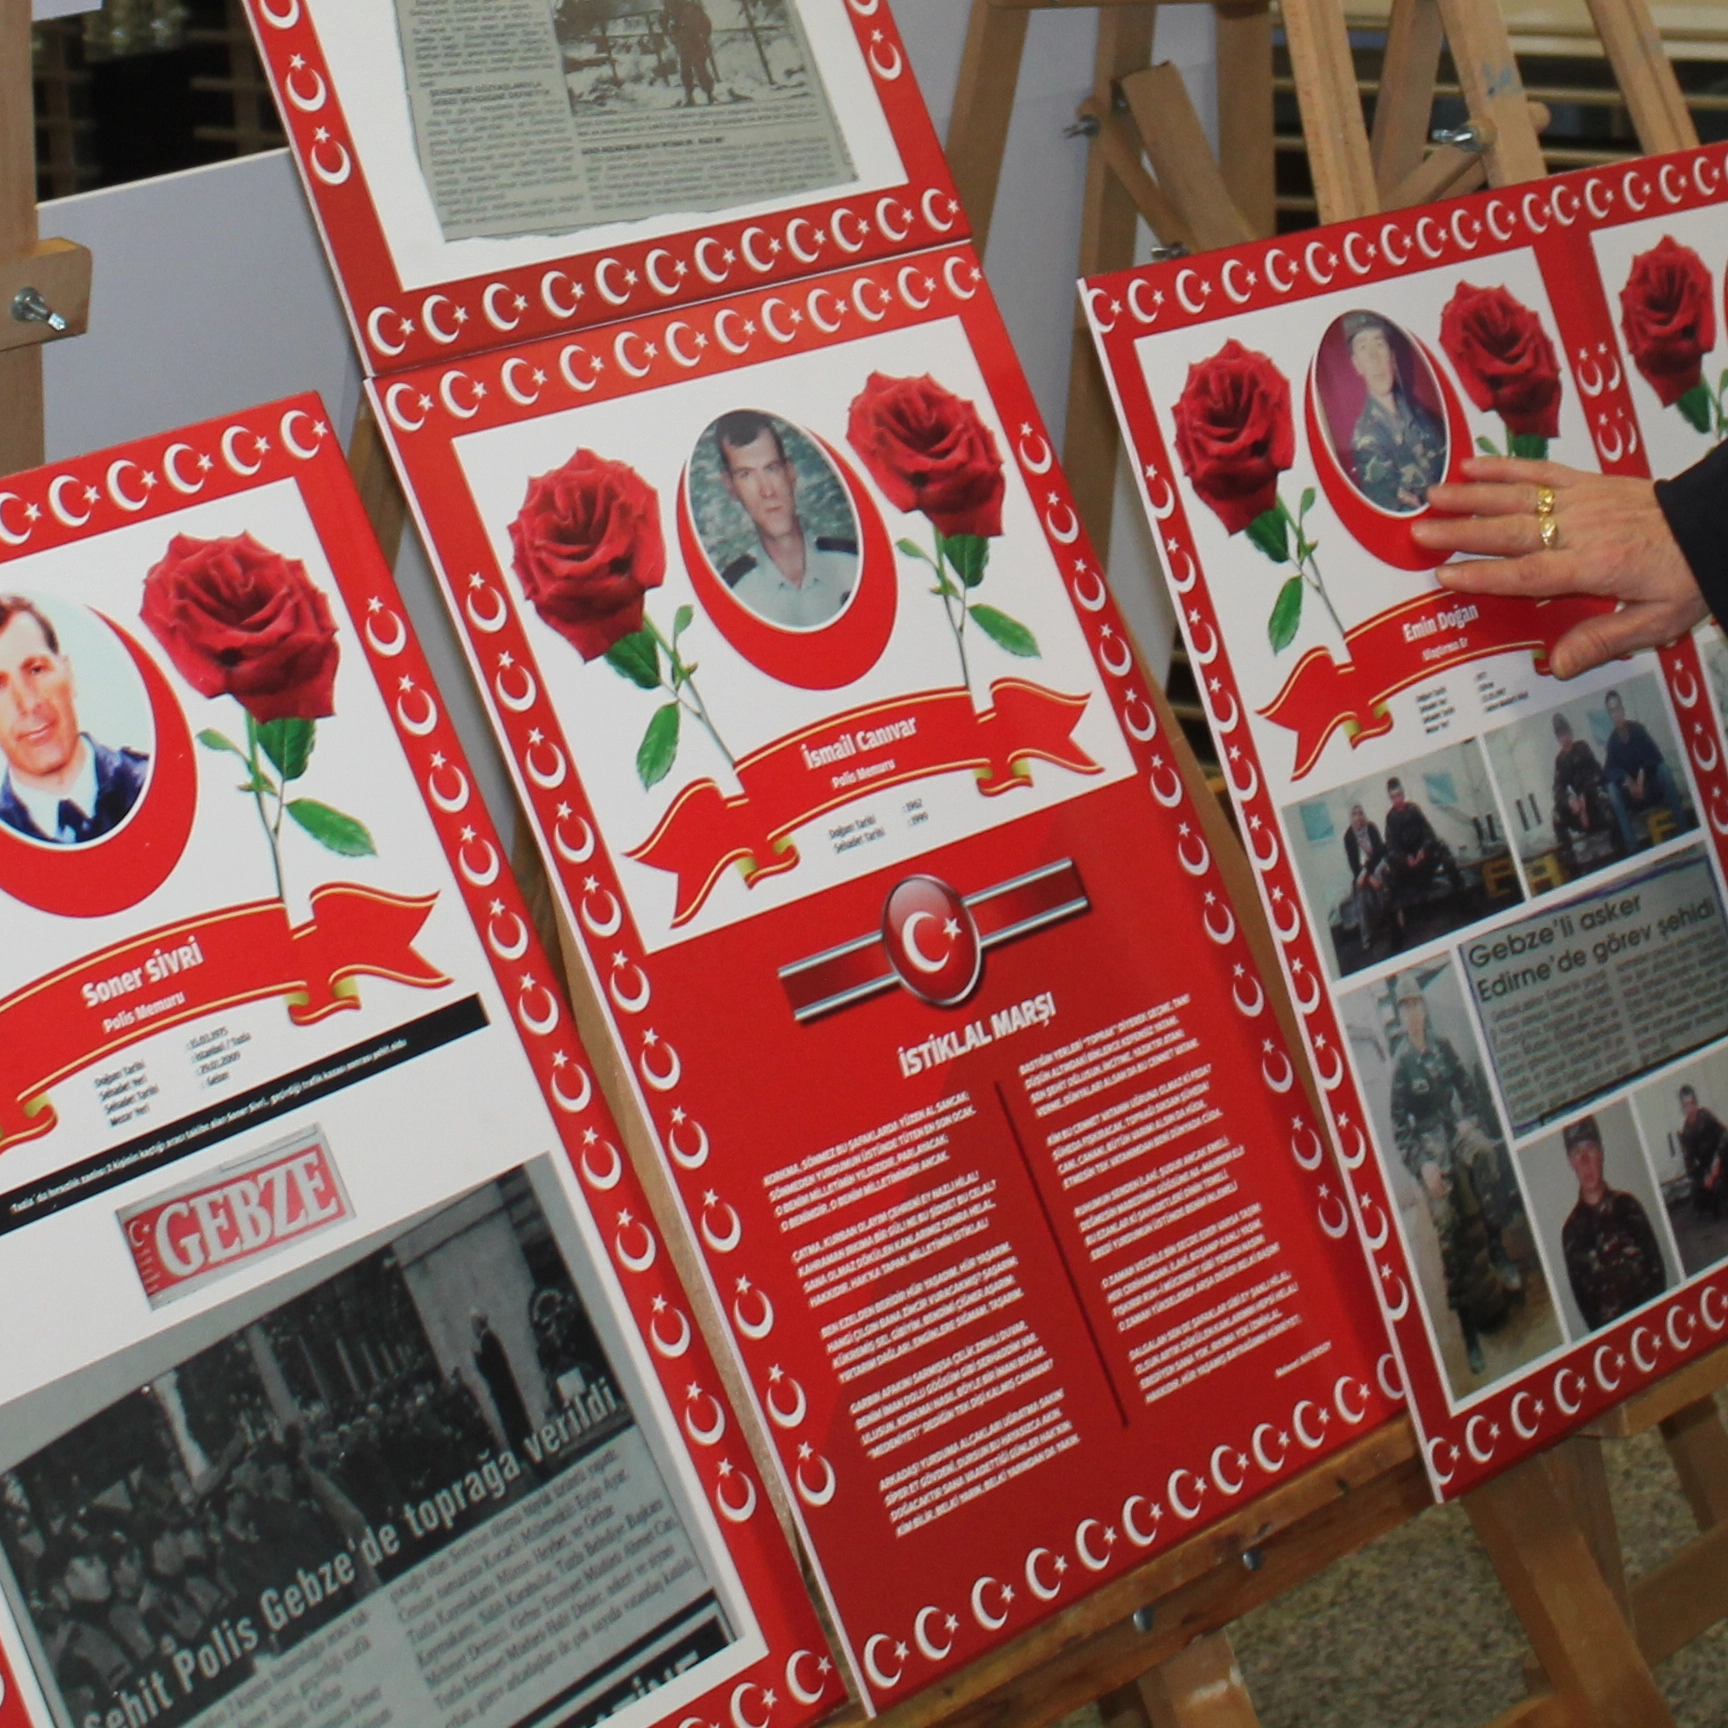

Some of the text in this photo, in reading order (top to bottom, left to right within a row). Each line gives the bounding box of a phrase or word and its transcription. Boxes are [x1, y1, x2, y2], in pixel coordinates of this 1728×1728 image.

[1402, 615, 1437, 642] Emin
[801, 733, 857, 771] İsmail
[1469, 894, 1641, 968] Gebze'li asker
[1477, 896, 1715, 1002] Edirne'de görev şehidi
[81, 934, 204, 1008] Soner SİVRİ
[102, 991, 186, 1034] Polis Memuru
[898, 992, 1058, 1079] İSTİKLAL MARŞI
[152, 1154, 341, 1279] GEBZE
[172, 1616, 259, 1694] Polis
[260, 1527, 401, 1638] Gebze'de
[403, 1440, 522, 1539] toprağa
[523, 1375, 619, 1465] verildi
